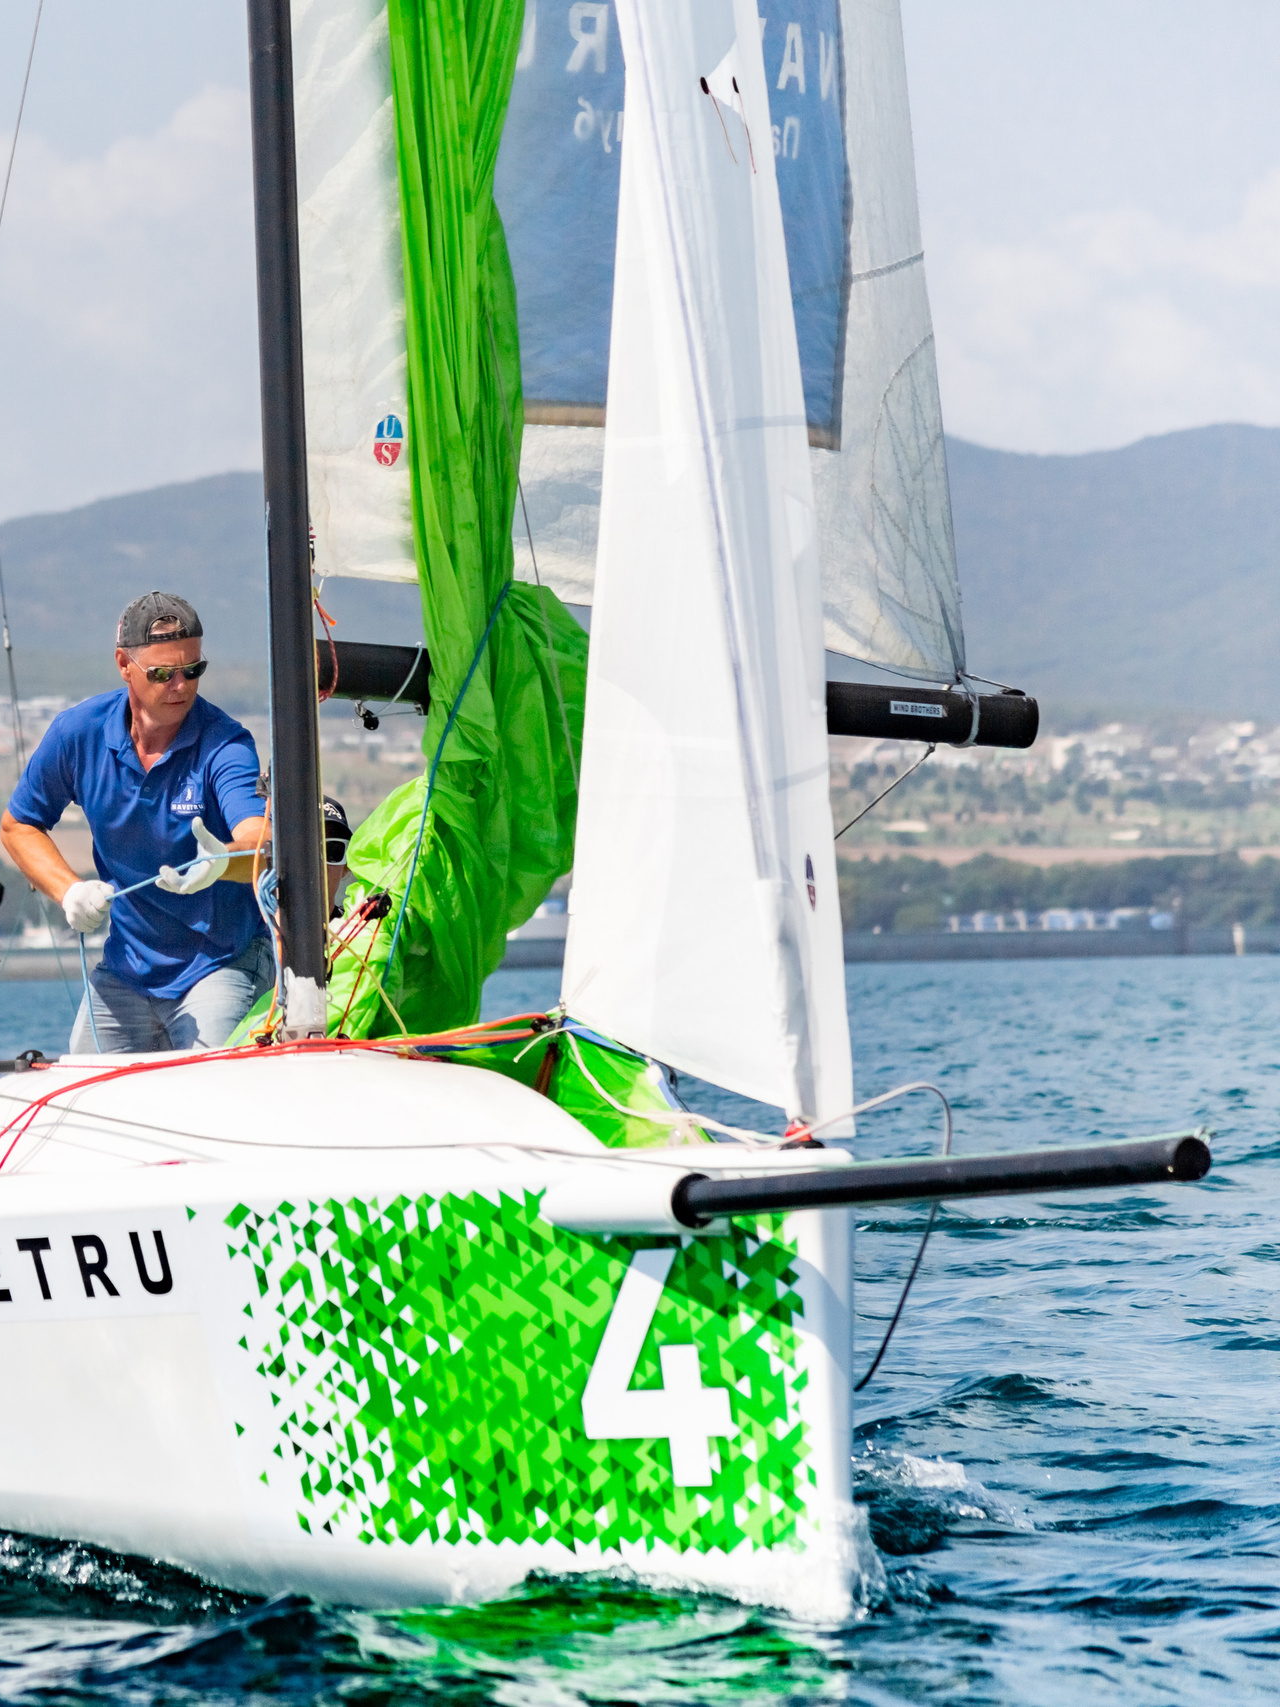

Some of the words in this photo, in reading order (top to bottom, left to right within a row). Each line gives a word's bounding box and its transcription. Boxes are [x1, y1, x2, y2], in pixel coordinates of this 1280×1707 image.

[893, 703, 909, 713] WIND
[910, 704, 940, 716] BROTHERS
[581, 1248, 735, 1487] 4
